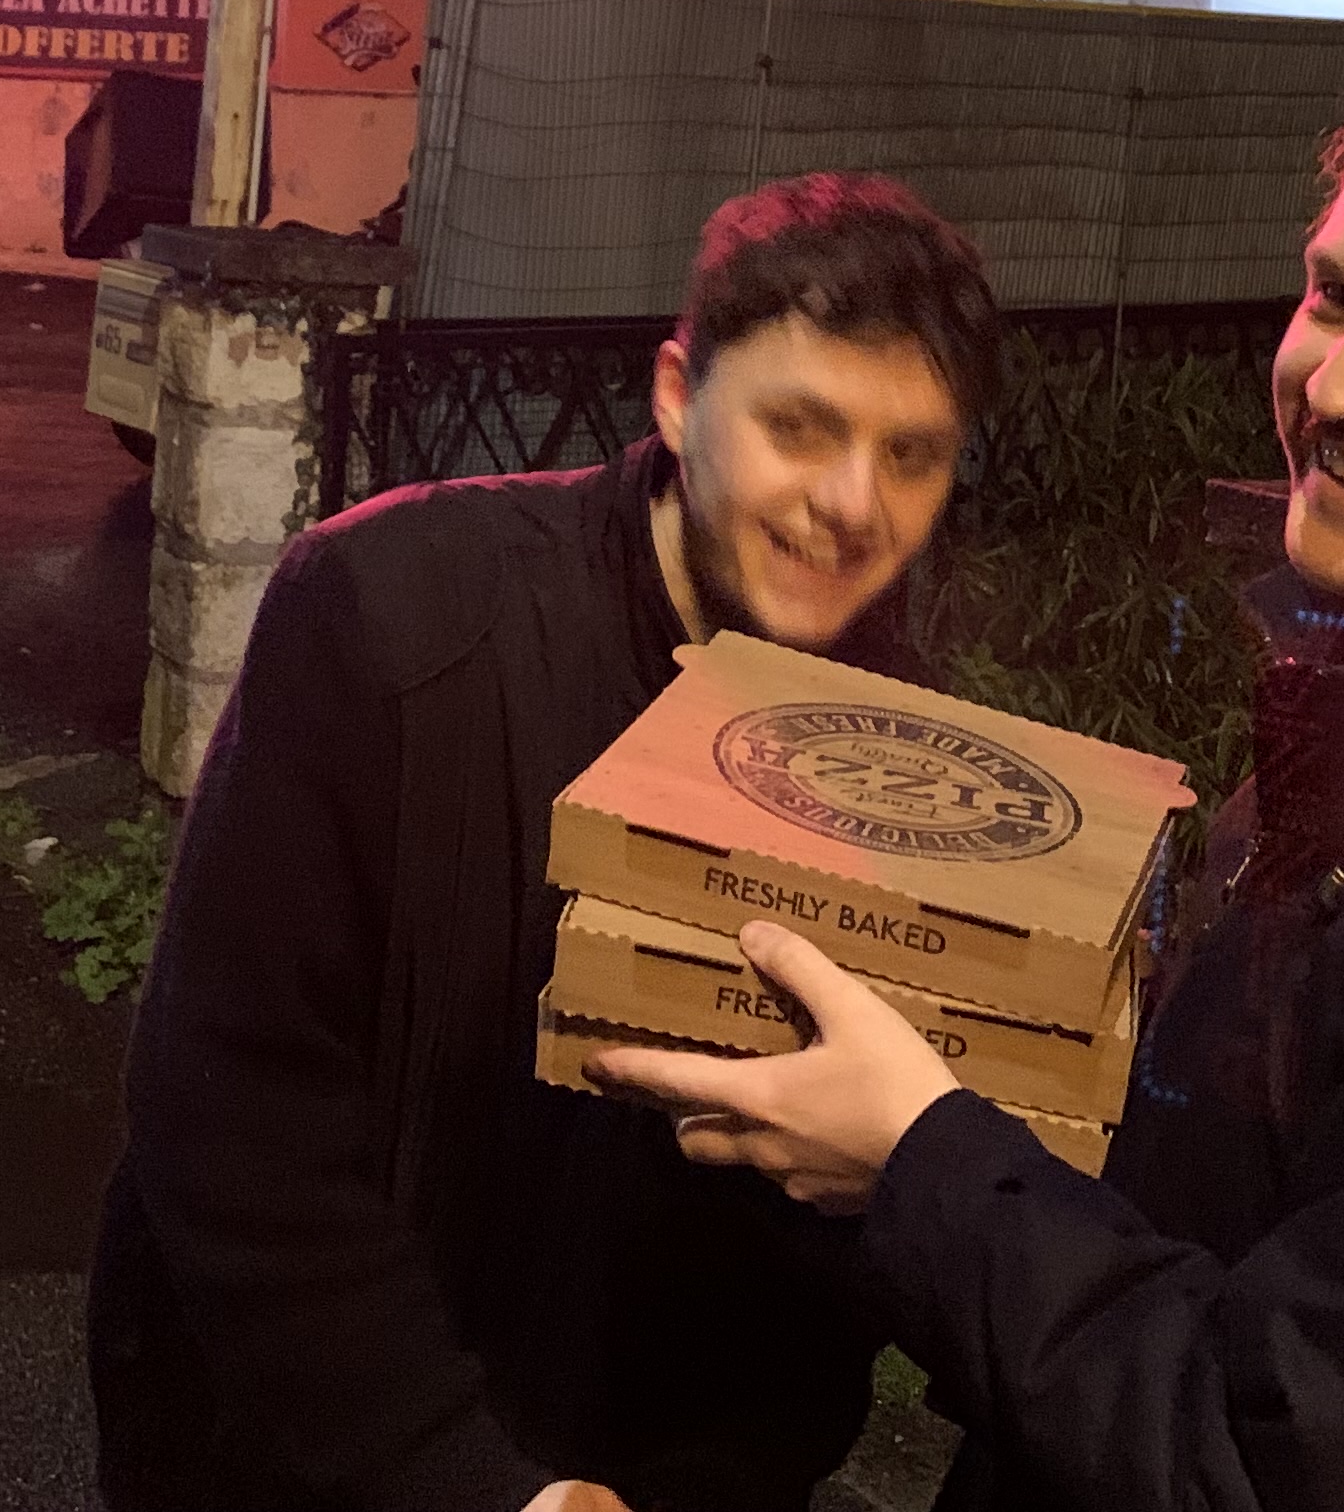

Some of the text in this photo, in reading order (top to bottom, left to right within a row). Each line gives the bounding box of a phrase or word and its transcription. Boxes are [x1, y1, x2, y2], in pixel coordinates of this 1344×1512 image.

[789, 714, 1015, 775] MADE FRESH
[735, 735, 1054, 824] PIZZA
[783, 796, 998, 850] DELICIOUS
[704, 867, 947, 955] FRESHLY BAKED
[715, 986, 790, 1025] FRES
